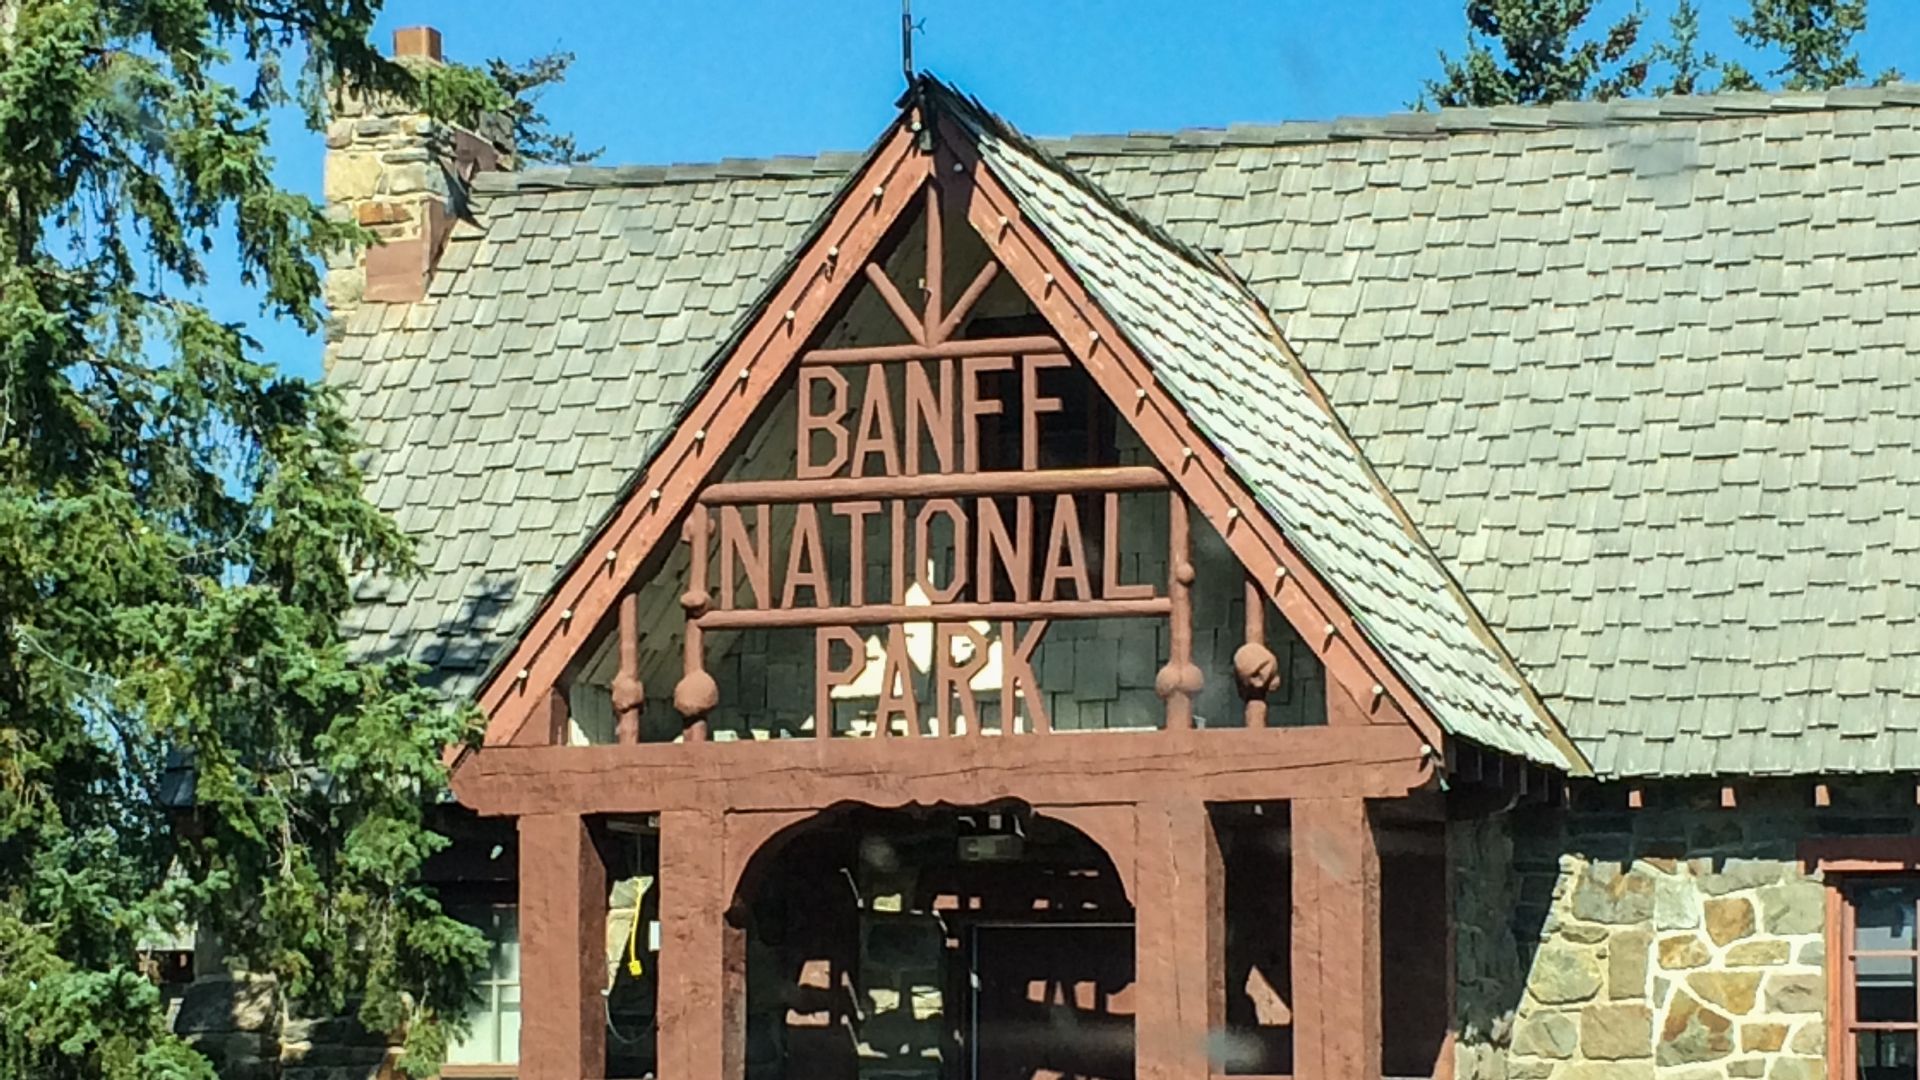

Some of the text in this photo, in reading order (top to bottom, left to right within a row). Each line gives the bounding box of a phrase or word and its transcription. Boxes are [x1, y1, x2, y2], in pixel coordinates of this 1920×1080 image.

[797, 354, 1072, 480] BANFF
[720, 492, 1155, 611] NATIONAL
[814, 619, 1053, 739] PARK
